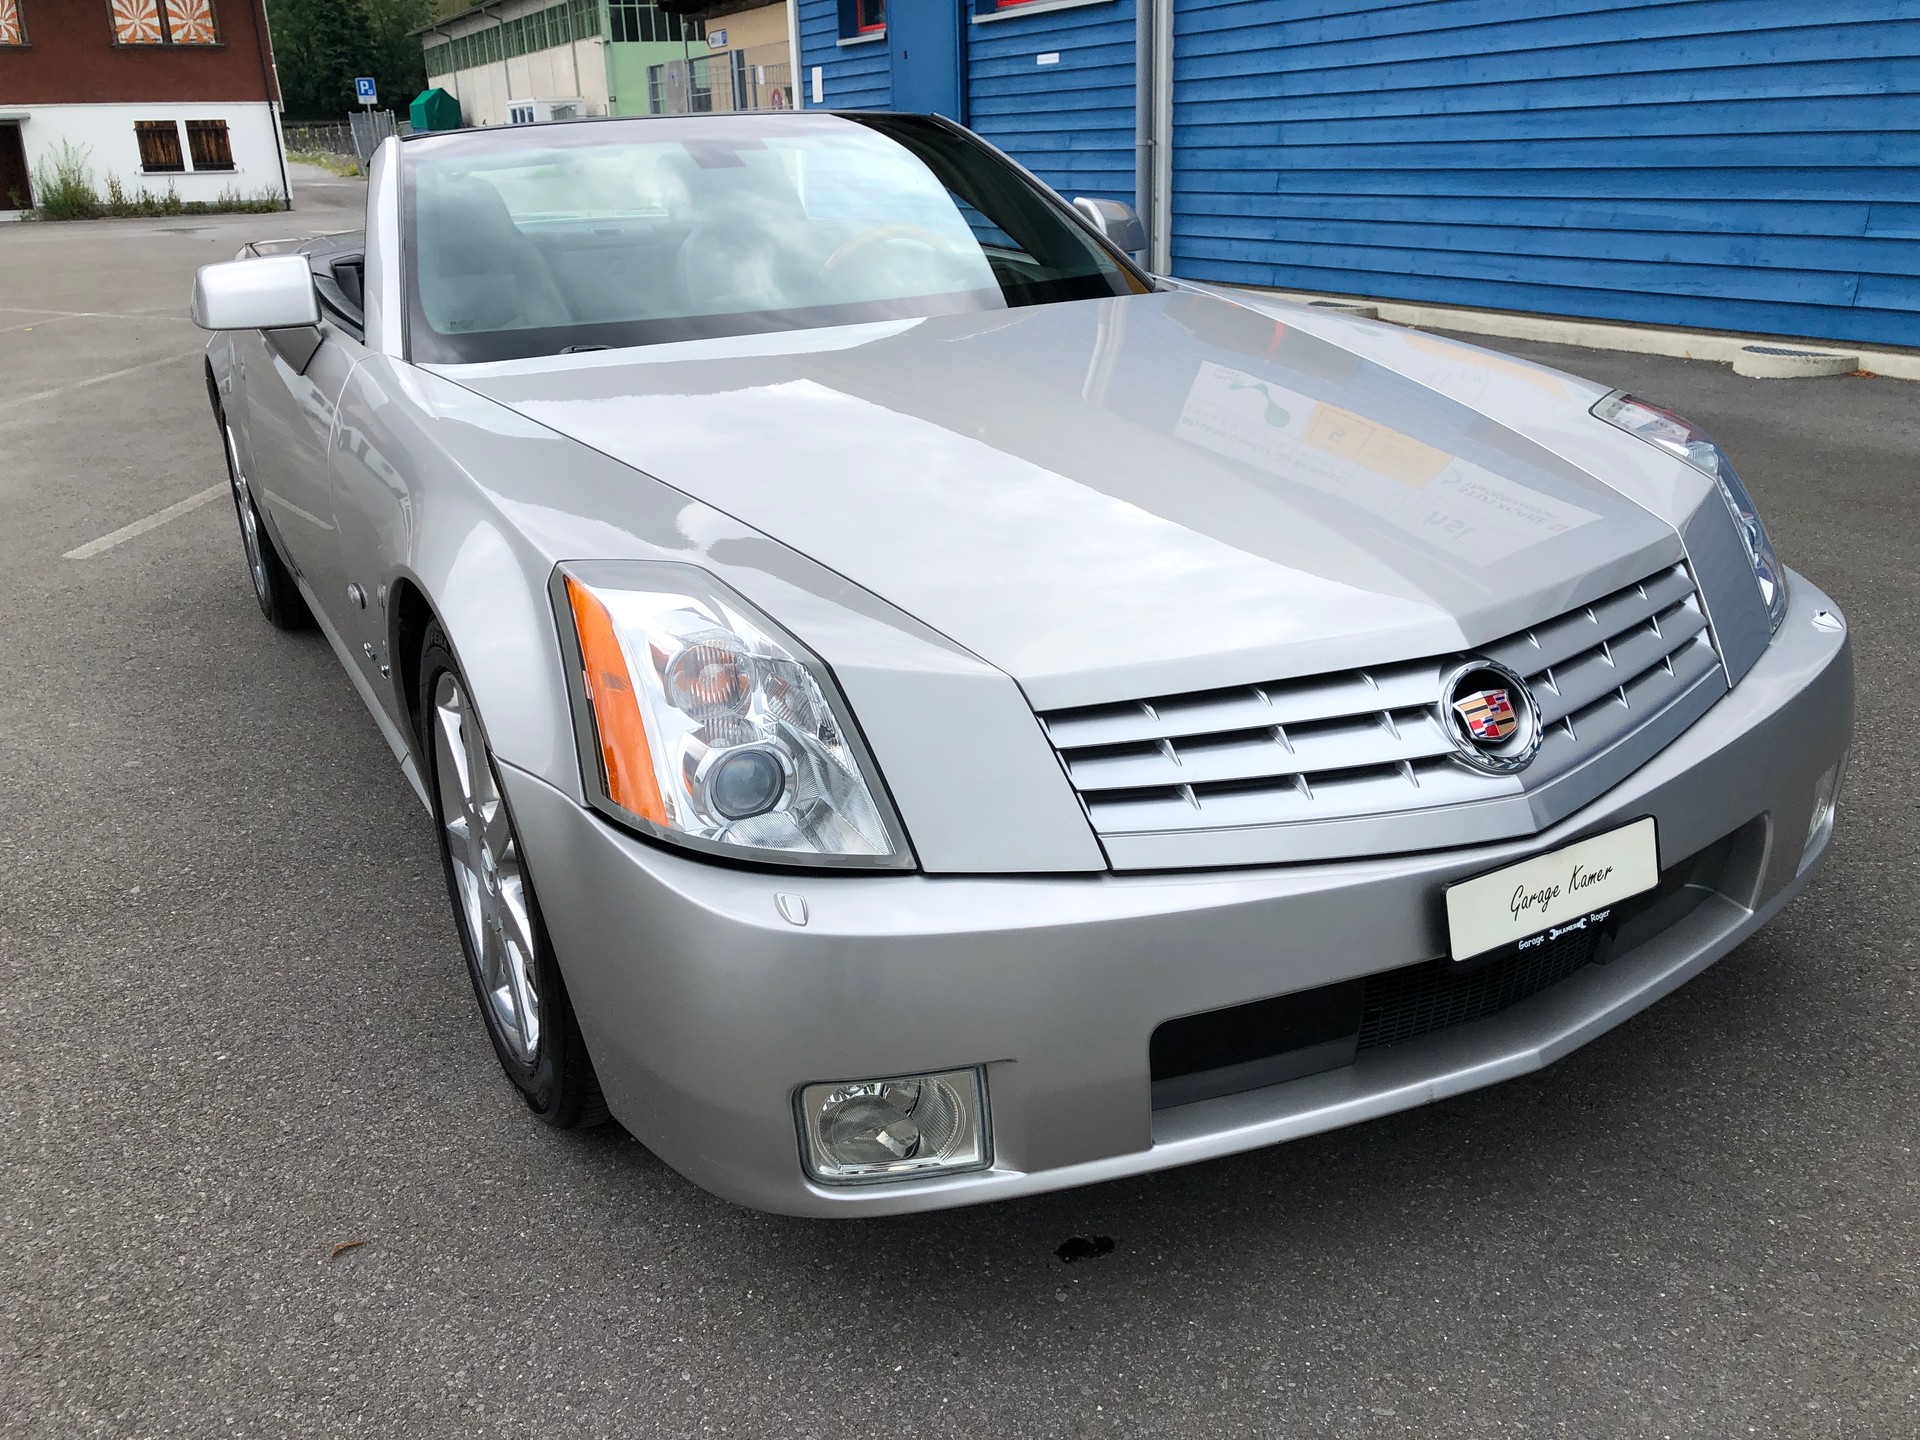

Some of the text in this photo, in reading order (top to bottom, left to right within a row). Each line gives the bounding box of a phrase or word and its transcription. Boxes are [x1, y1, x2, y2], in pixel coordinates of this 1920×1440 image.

[360, 81, 370, 94] P
[1510, 865, 1613, 921] Garage Kamer
[1518, 909, 1611, 950] Garage KAMER Roger
